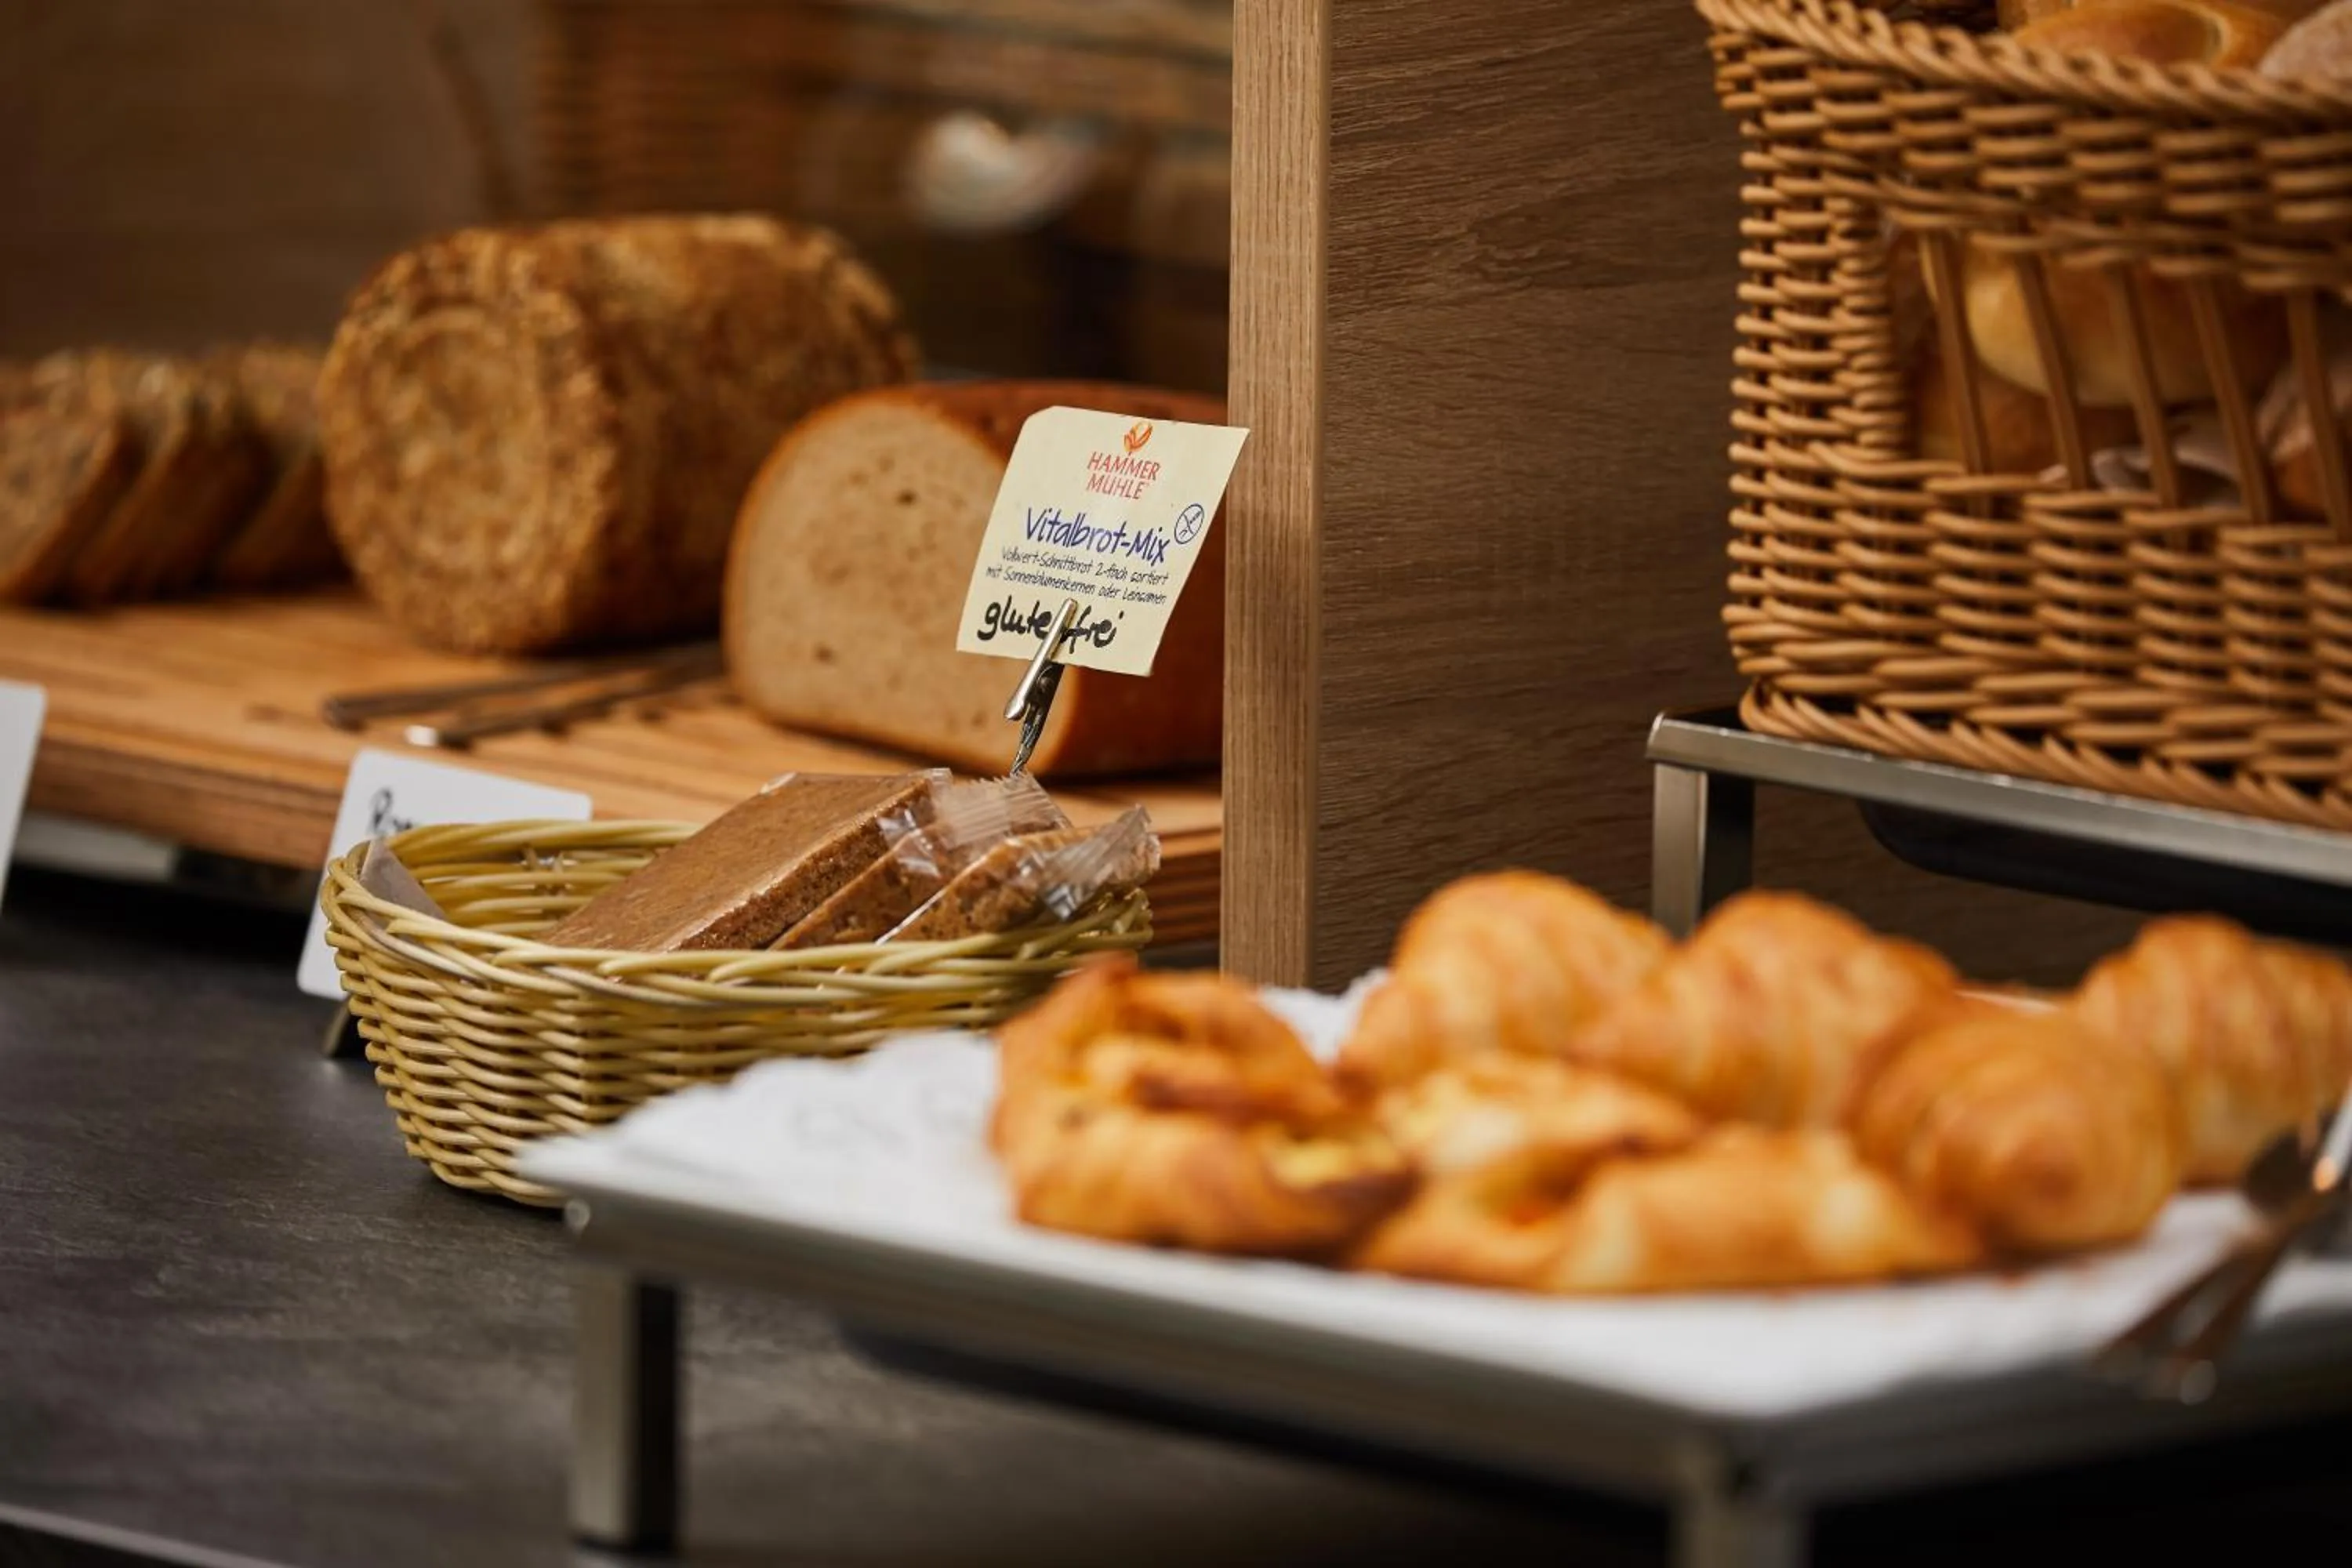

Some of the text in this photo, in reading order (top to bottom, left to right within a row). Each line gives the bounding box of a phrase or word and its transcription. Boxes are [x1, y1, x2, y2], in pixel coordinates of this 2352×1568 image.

[1087, 451, 1162, 481] HAMMER
[1027, 507, 1171, 567] Vitalbrot-Mix
[1098, 583, 1121, 598] oder
